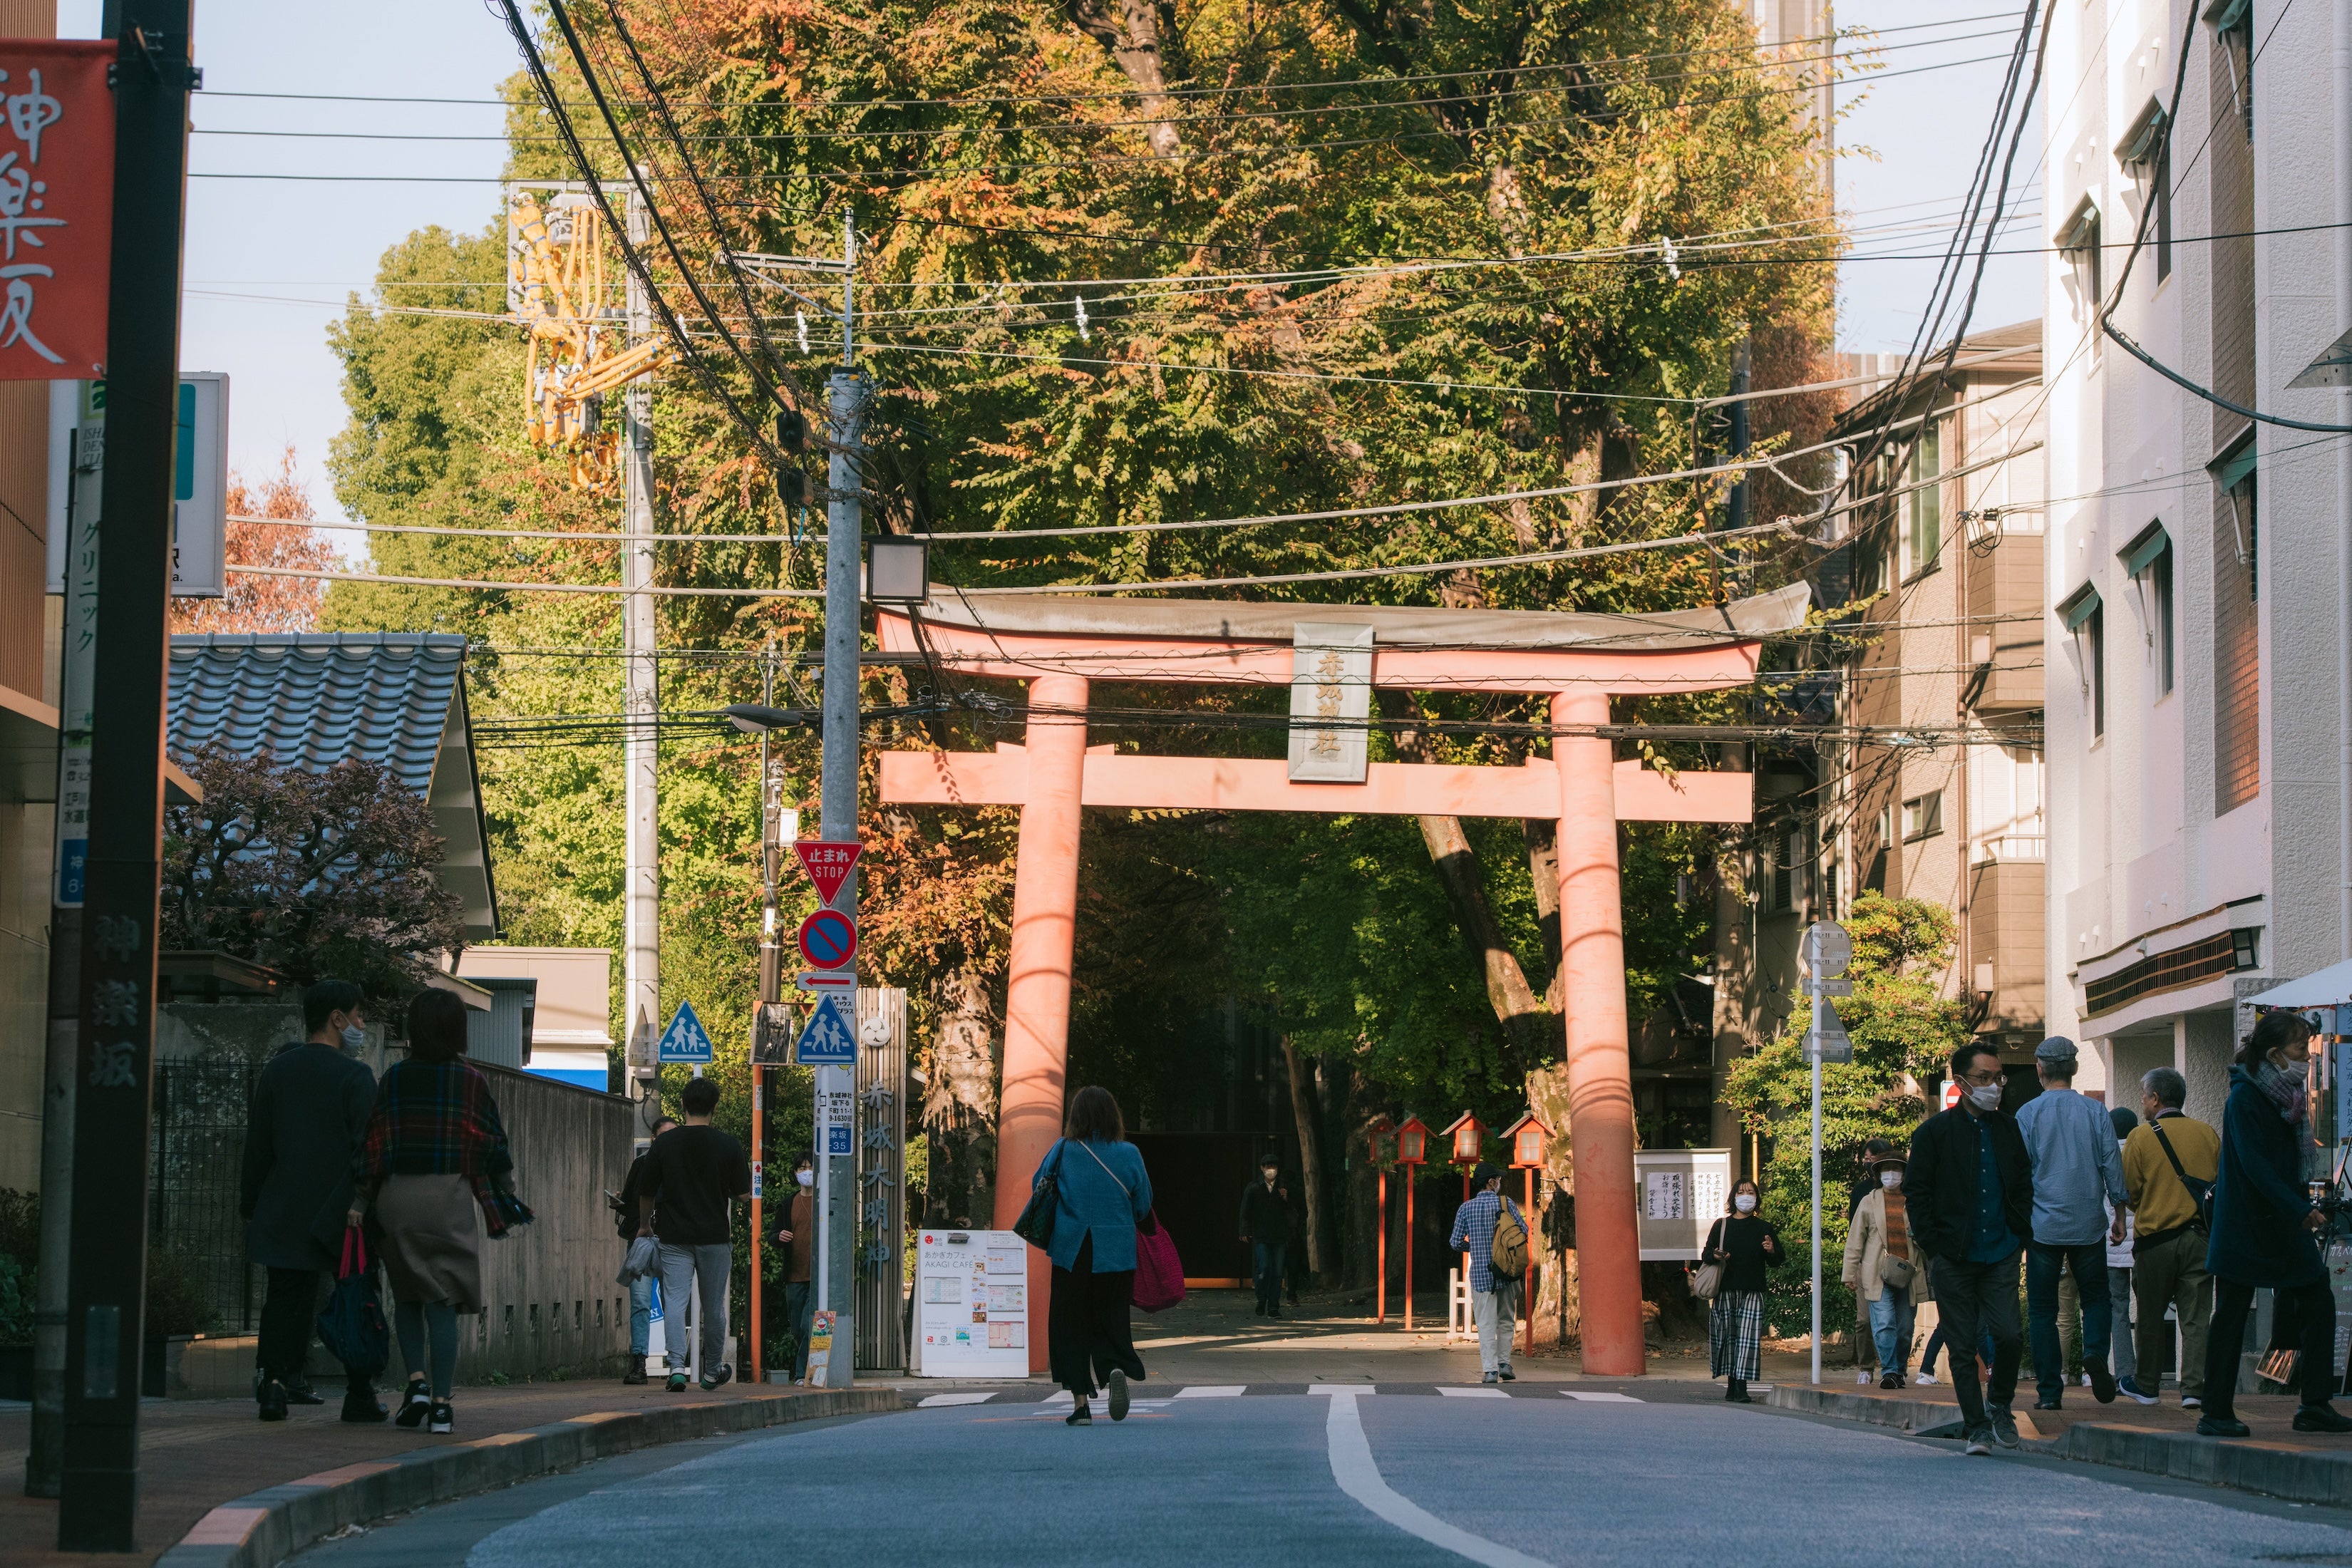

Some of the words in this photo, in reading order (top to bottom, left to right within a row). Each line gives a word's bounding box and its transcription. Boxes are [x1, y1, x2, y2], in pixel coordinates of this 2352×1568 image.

[78, 522, 98, 653] クリニック
[1310, 650, 1343, 754] 赤城神社
[808, 848, 850, 863] 止まれ
[815, 866, 844, 878] STOP
[754, 1175, 762, 1196] 注意
[860, 1078, 896, 1281] 赤城大明神
[1671, 1174, 1681, 1219] 頑張れ受験生
[952, 1259, 974, 1268] CAFÉ
